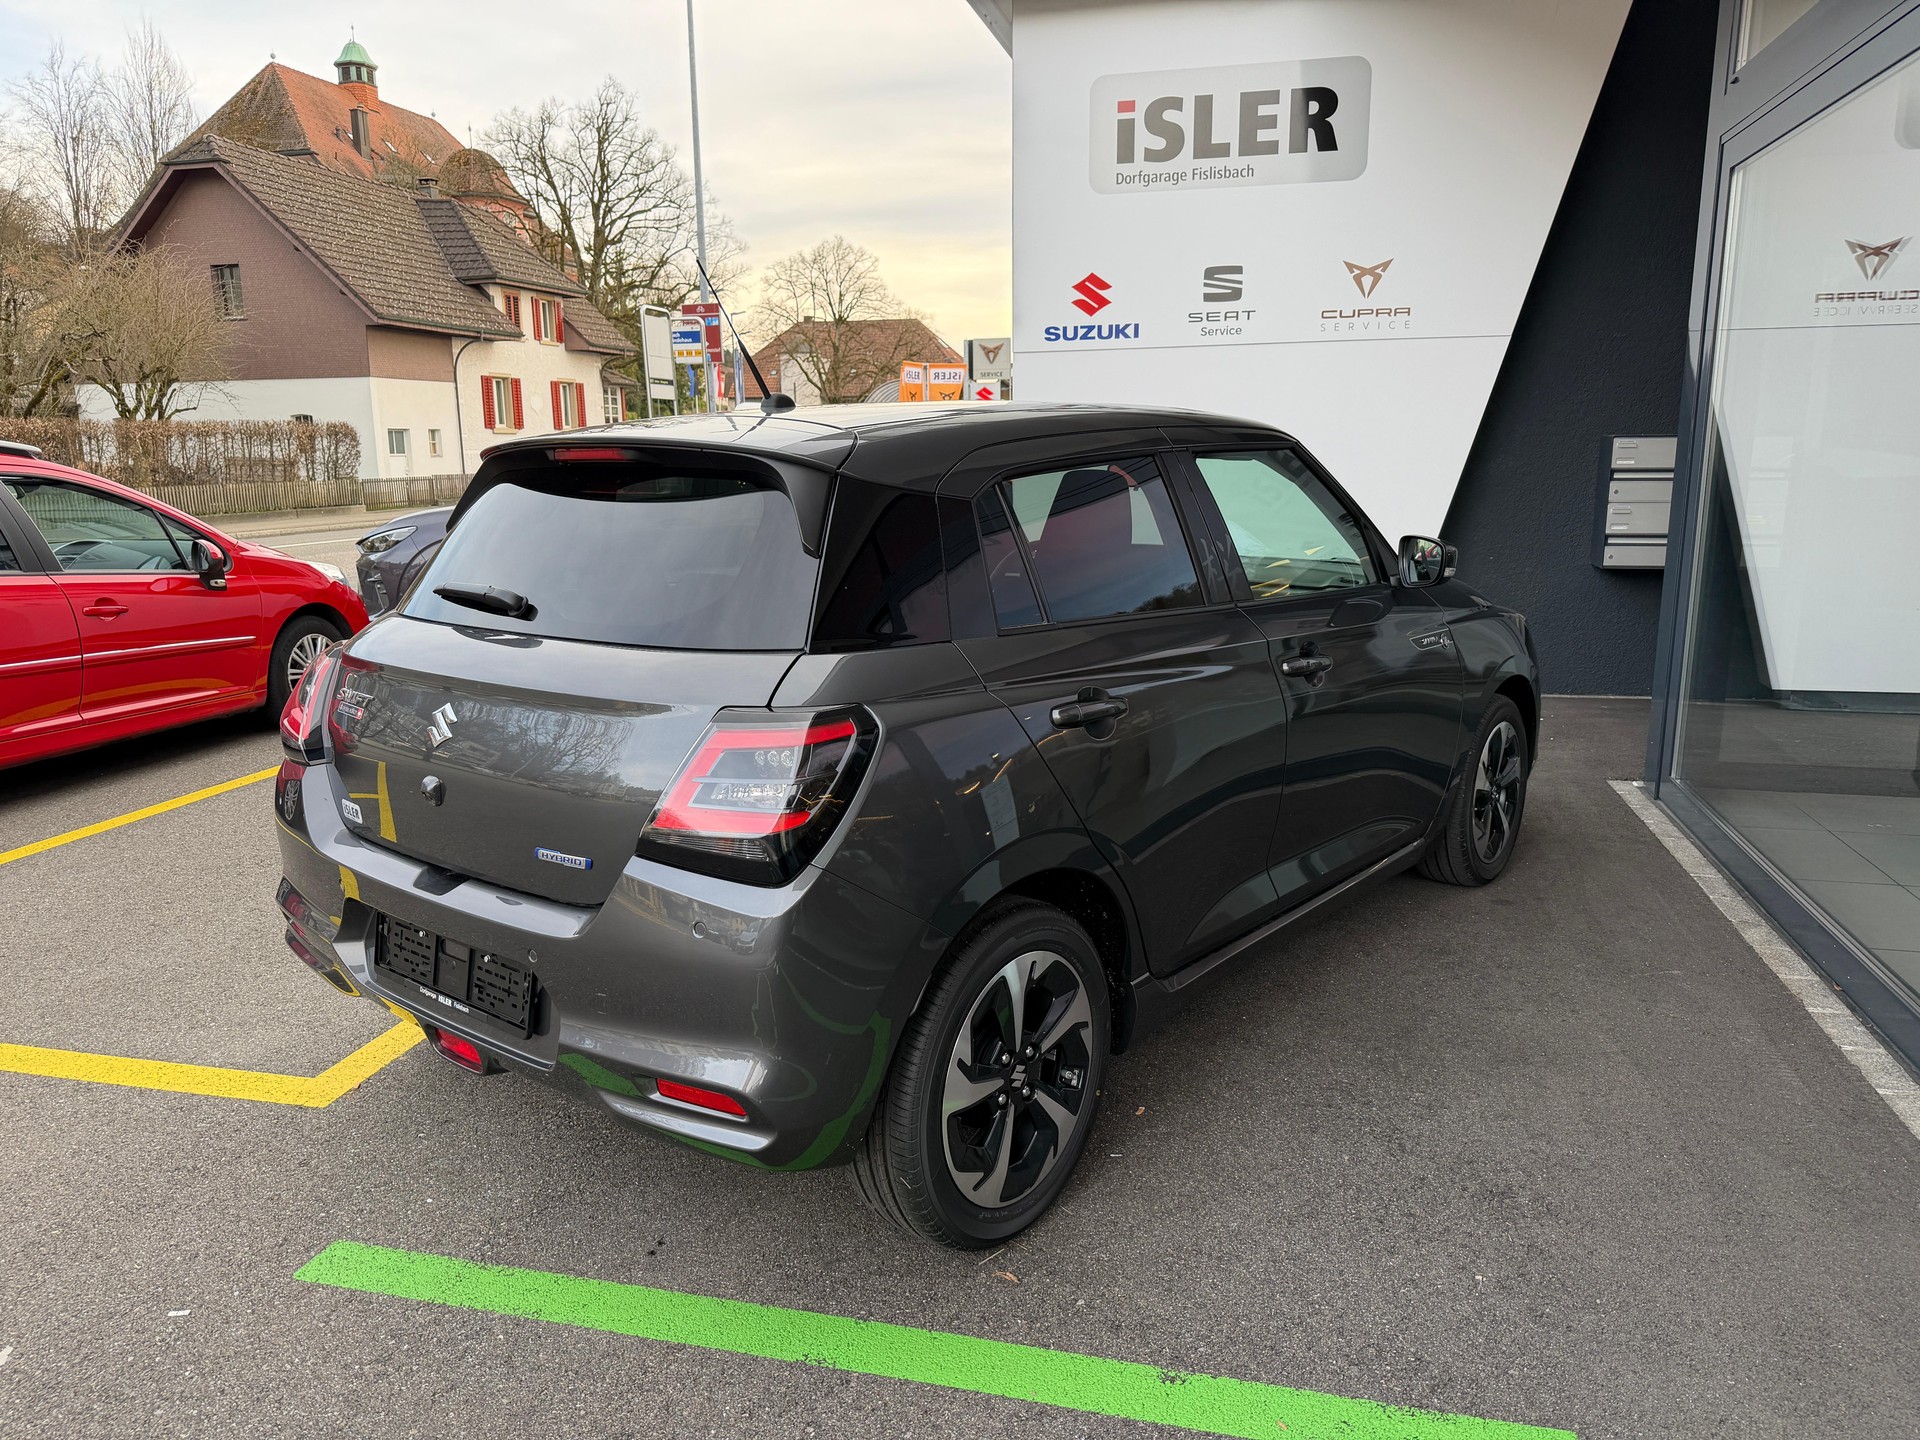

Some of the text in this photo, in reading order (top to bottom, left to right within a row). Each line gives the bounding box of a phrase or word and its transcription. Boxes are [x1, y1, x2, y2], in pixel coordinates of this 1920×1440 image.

[1116, 86, 1339, 165] iSLER
[1115, 163, 1255, 188] Dorfgarage Fislisbach
[1187, 309, 1257, 323] SEAT
[1320, 306, 1412, 319] CUPRA
[1043, 322, 1140, 342] SUZUKI
[1199, 325, 1243, 337] Service
[1319, 319, 1412, 333] SERVICE
[980, 370, 1004, 378] SERVICE
[336, 687, 375, 708] SWIFT
[541, 851, 583, 867] HYBRID
